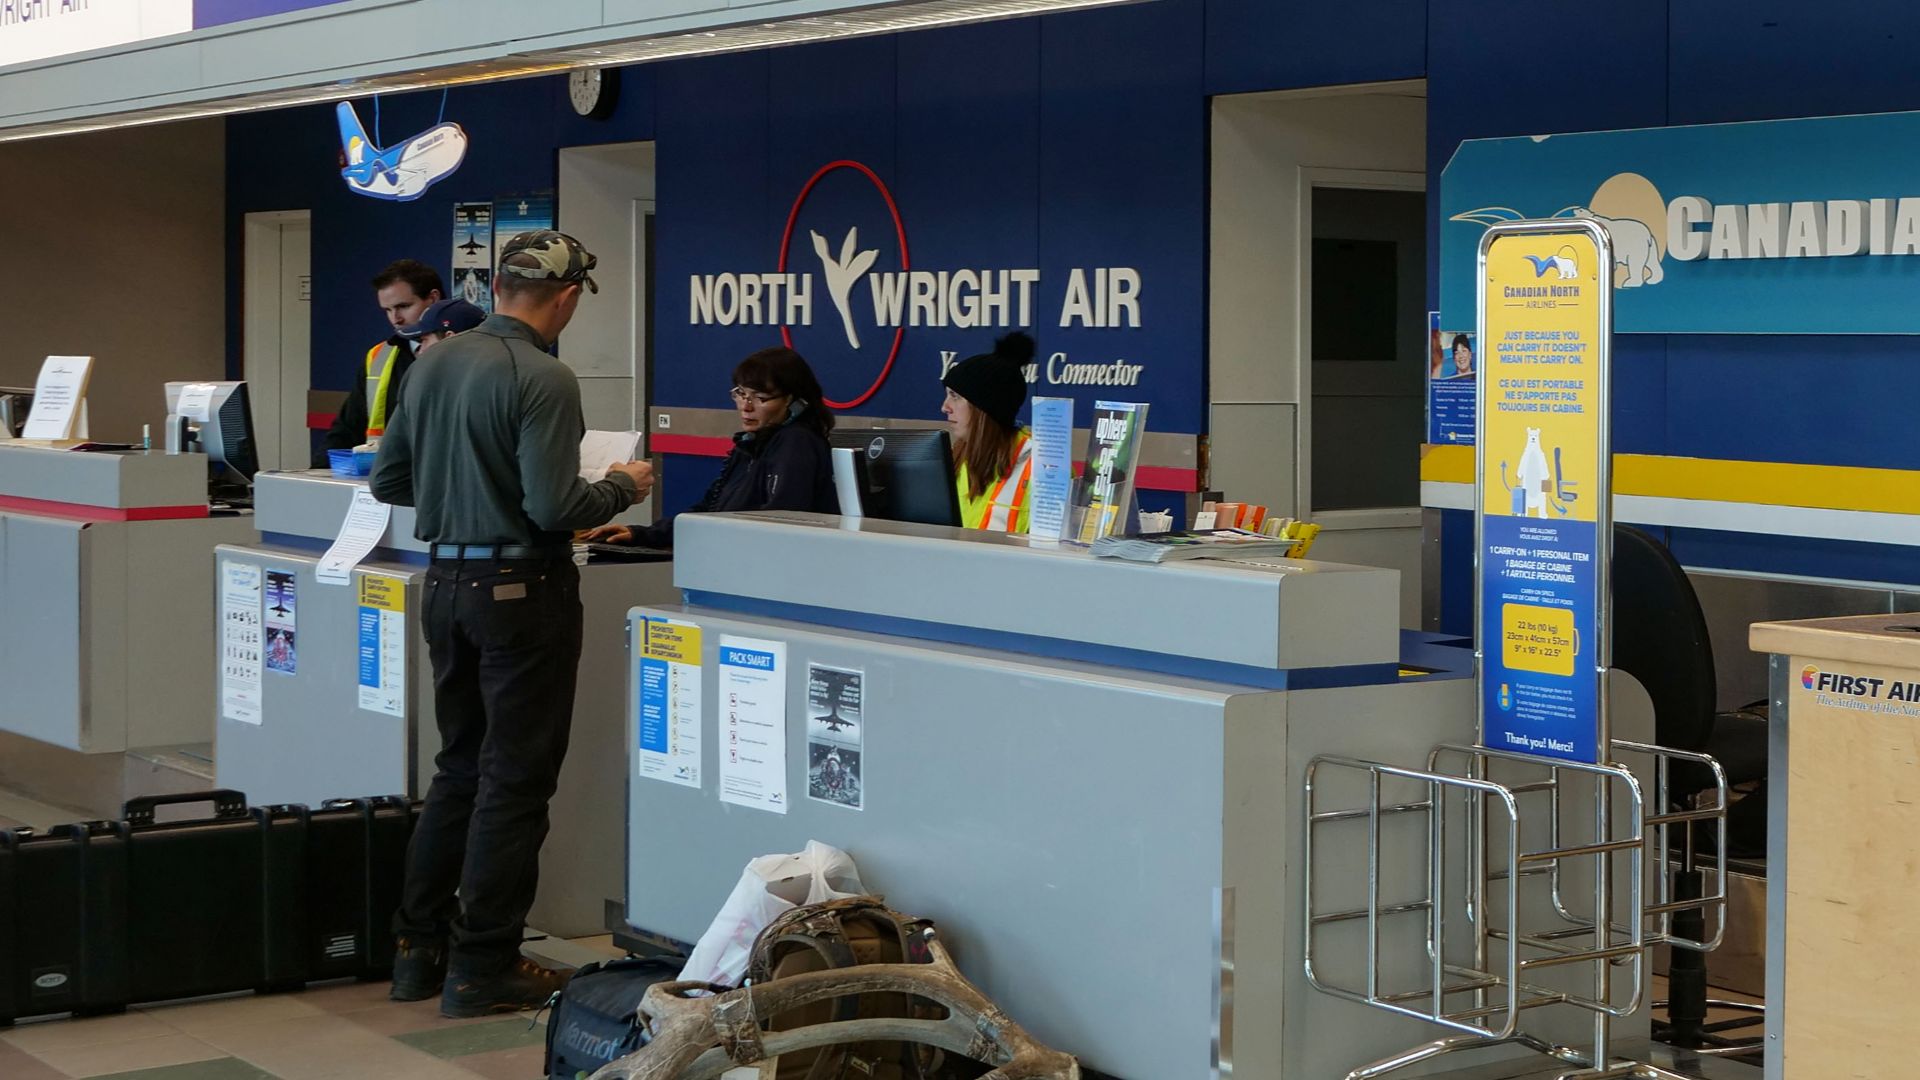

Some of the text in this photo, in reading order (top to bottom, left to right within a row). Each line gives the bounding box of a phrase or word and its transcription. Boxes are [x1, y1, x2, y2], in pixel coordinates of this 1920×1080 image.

[690, 267, 1141, 329] NORTH WRIGHT AIR
[1504, 285, 1580, 298] CANADIAN NORTH
[1526, 301, 1557, 309] AIRLINES
[1504, 331, 1579, 340] JUST BECAUSE YOU
[1497, 343, 1587, 352] CAN CARRY IT DOESN'T
[1500, 355, 1584, 364] MEAN IT'S CARRY ON.
[1047, 352, 1144, 386] Connector
[1499, 379, 1584, 389] CE QUI EST PORTABLE
[1505, 390, 1577, 401] NE S'APPORTE PAS
[1497, 402, 1585, 413] TOUJOURS EN CABINE.
[1489, 546, 1493, 554] 1
[1494, 546, 1527, 556] CARRY-ON
[1532, 549, 1536, 557] 1
[1537, 549, 1572, 560] PERSONAL
[1572, 552, 1590, 561] ITEM
[1510, 560, 1536, 569] BAGAGE
[1536, 562, 1545, 570] DE
[1546, 563, 1572, 573] CABINE
[1510, 569, 1536, 580] ARTICLE
[1537, 571, 1576, 583] PERSONNEL
[1517, 621, 1558, 634] 22 lbs (10 kg)
[1507, 631, 1523, 640] 23cm
[1530, 634, 1546, 643] 41cm
[1552, 637, 1569, 646] 57cm
[729, 651, 771, 667] PACK SMART
[1817, 672, 1884, 698] FIRST
[1816, 694, 1833, 706] The
[1837, 698, 1870, 710] Airline
[1870, 700, 1882, 713] of
[1882, 703, 1900, 714] the
[1505, 731, 1574, 752] Thank you! Merci!
